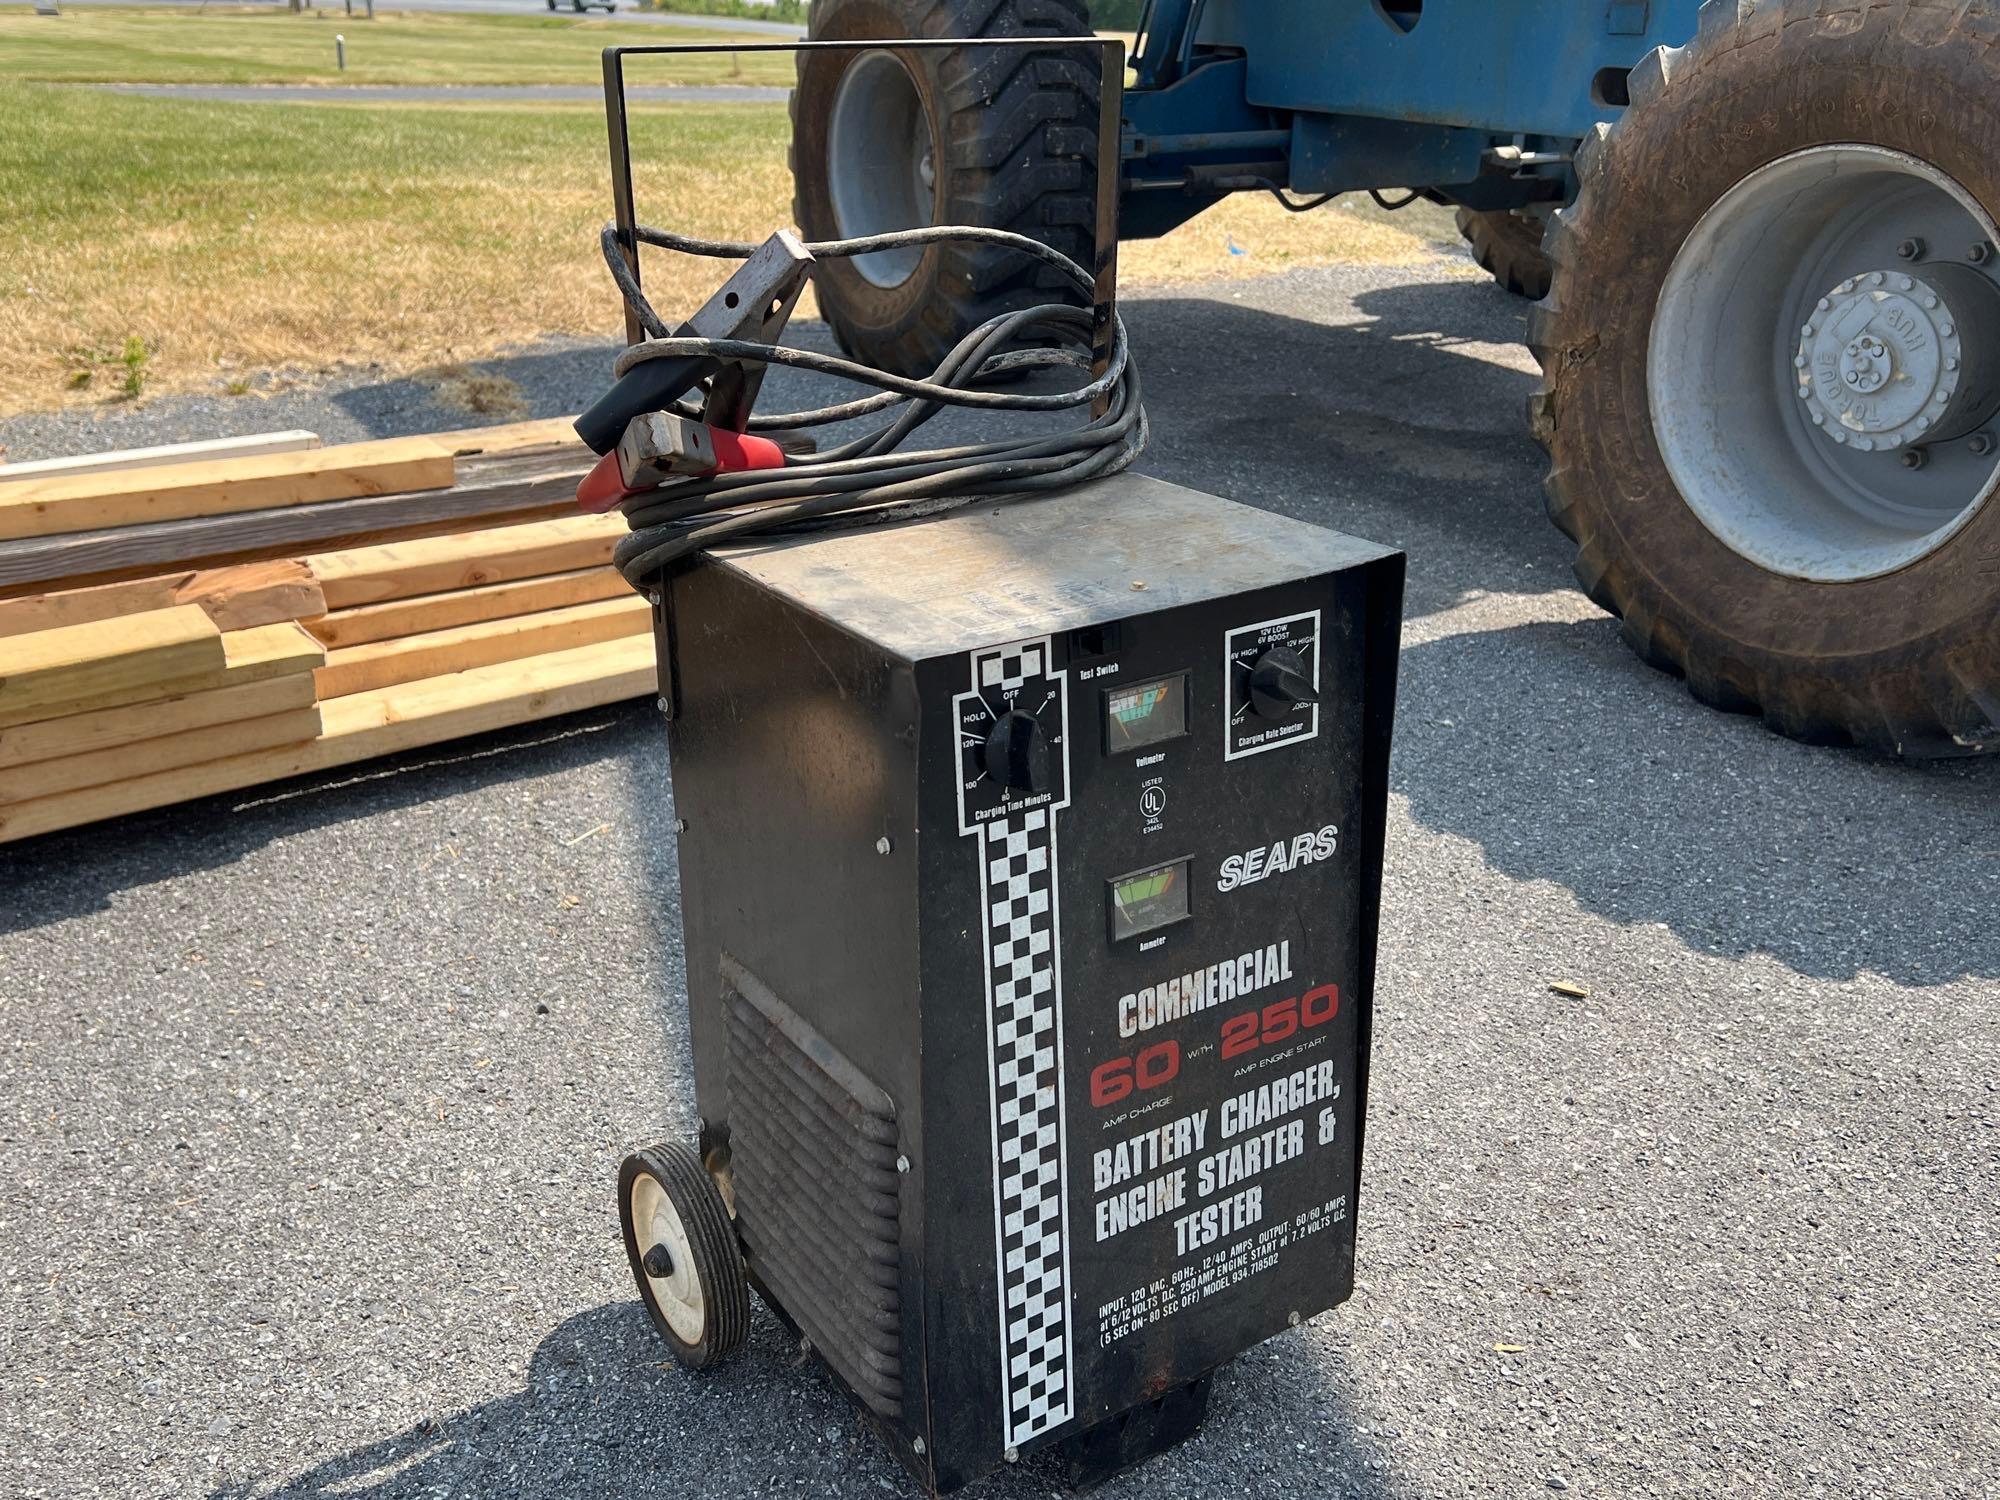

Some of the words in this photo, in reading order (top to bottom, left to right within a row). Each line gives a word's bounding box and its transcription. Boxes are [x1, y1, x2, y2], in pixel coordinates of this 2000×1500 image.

[1819, 351, 1882, 427] TORQUE
[1888, 307, 1926, 353] HUB
[1267, 631, 1290, 643] BOOST
[1272, 624, 1288, 634] LOW
[1287, 639, 1297, 648] 12V
[1298, 636, 1315, 645] HIGH
[1241, 647, 1258, 657] HIGH
[1080, 669, 1094, 680] Test
[1096, 662, 1119, 676] Switch
[1003, 689, 1020, 700] OFF
[1047, 691, 1056, 699] 20
[963, 711, 986, 723] HOLD
[1231, 716, 1245, 726] OFF
[962, 739, 975, 748] 120
[1238, 733, 1264, 747] Charging
[1265, 727, 1279, 740] Rate
[1280, 722, 1304, 736] Selector
[1136, 753, 1165, 767] Voltmeter
[965, 781, 977, 790] 100
[1141, 776, 1163, 788] LISTED
[1001, 793, 1010, 801] 80
[1145, 792, 1160, 811] UL
[975, 804, 1006, 820] Charging
[1007, 799, 1024, 811] Time
[1024, 793, 1051, 807] Minutes
[1217, 824, 1339, 893] SEARS
[1140, 936, 1167, 952] Ammeter
[1118, 939, 1293, 1038] COMMERCIAL
[1090, 1039, 1180, 1108] 60
[1187, 1043, 1214, 1060] WITH
[1220, 983, 1339, 1060] 250
[1233, 1063, 1257, 1078] AMP
[1259, 1050, 1294, 1068] ENGINE
[1296, 1035, 1327, 1054] START
[1102, 1113, 1127, 1130] AMP
[1129, 1095, 1173, 1119] CHARGE
[1093, 1109, 1209, 1193] BATTERY
[1220, 1059, 1341, 1139] CHARGER,
[1095, 1167, 1186, 1243] ENGINE
[1198, 1118, 1304, 1198] STARTER
[1318, 1106, 1336, 1146] &
[1174, 1185, 1263, 1257] TESTER
[1099, 1296, 1127, 1319] INPUT:
[1131, 1287, 1146, 1304] 120
[1203, 1250, 1226, 1270] 12/40
[1230, 1238, 1253, 1257] AMPS
[1258, 1220, 1292, 1245] OUTPUT:
[1296, 1206, 1320, 1226] 60/60
[1324, 1195, 1346, 1214] AMPS
[1100, 1318, 1109, 1332] at
[1111, 1308, 1131, 1327] 6/12
[1132, 1295, 1158, 1317] VOLTS
[1180, 1277, 1196, 1295] 250
[1197, 1268, 1215, 1287] AMP
[1217, 1253, 1248, 1278] ENGINE
[1250, 1239, 1277, 1261] START
[1280, 1235, 1288, 1248] at
[1307, 1215, 1331, 1235] VOLTS
[1113, 1323, 1129, 1341] SEC
[1149, 1308, 1161, 1323] 80
[1163, 1300, 1179, 1317] SEC
[1181, 1289, 1200, 1308] OFF)
[1203, 1277, 1230, 1298] MODEL
[1232, 1252, 1279, 1284] 934.718502
